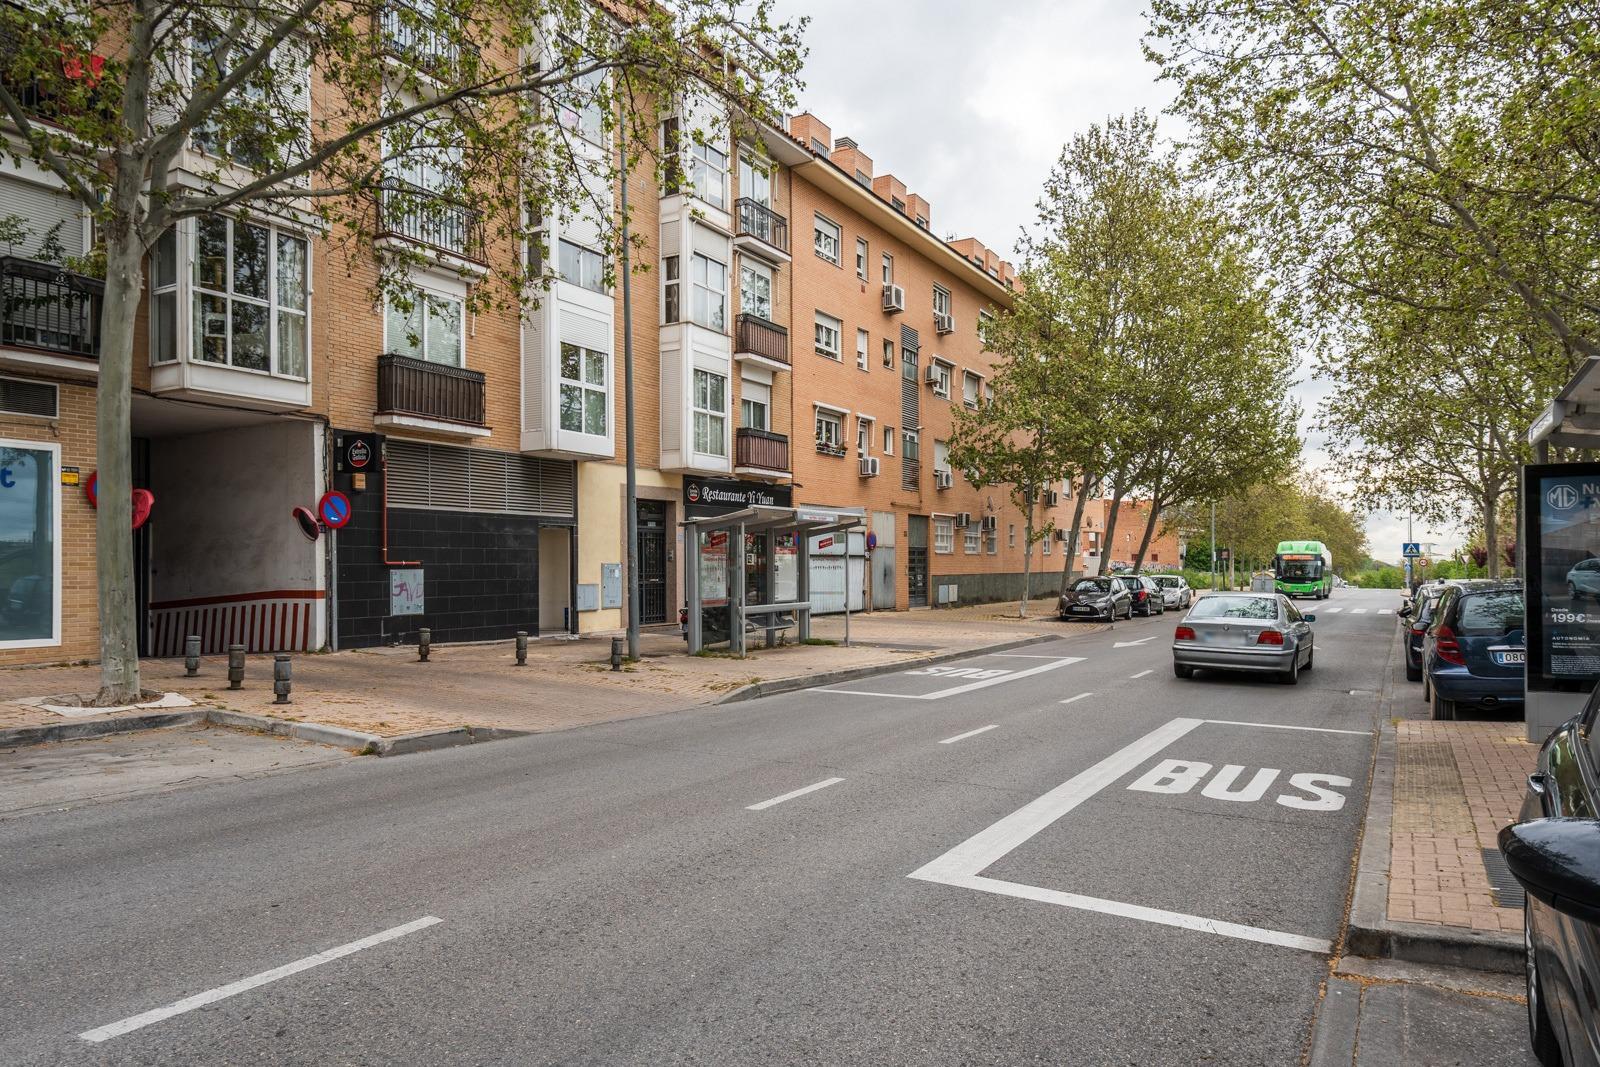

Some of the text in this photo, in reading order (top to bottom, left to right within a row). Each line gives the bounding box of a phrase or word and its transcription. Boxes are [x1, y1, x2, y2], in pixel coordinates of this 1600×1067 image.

[702, 486, 746, 502] Restaurante
[747, 490, 756, 504] Yi
[756, 491, 774, 505] Yuan
[1547, 485, 1578, 510] MG
[1551, 613, 1586, 623] 199€
[1126, 759, 1352, 812] BUS
